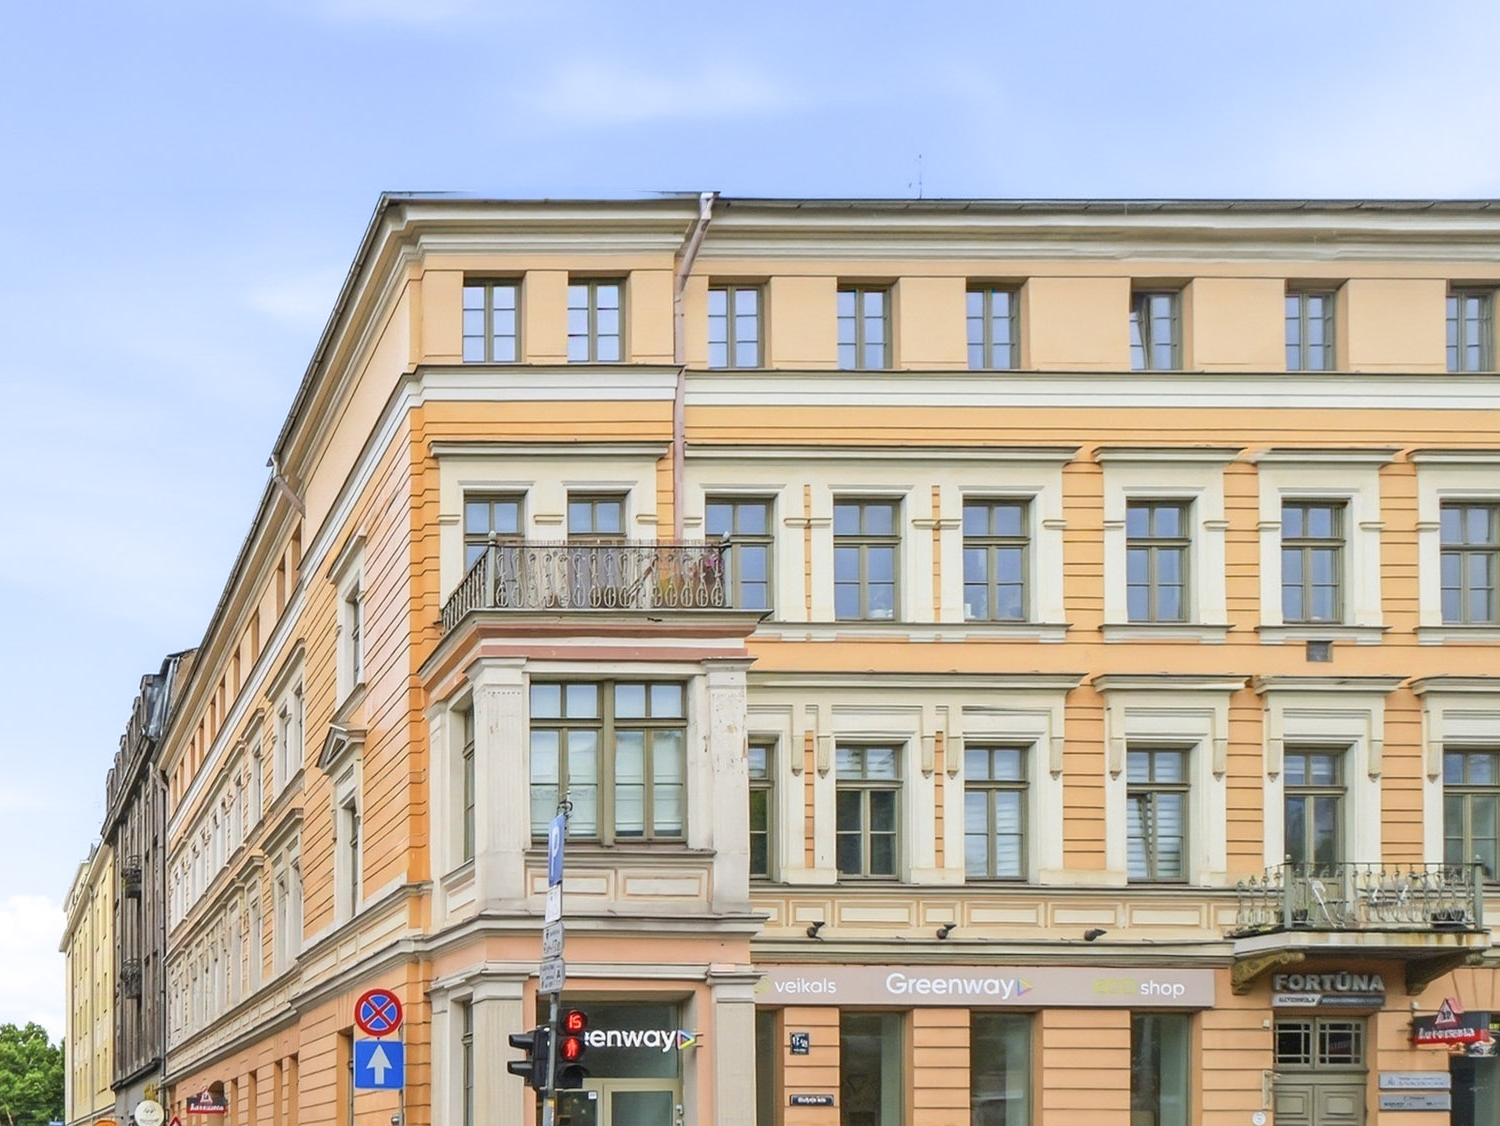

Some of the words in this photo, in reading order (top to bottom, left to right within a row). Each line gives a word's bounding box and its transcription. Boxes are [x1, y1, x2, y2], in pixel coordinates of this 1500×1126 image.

[774, 977, 837, 994] veikals
[886, 972, 1014, 1000] Greenway
[1140, 980, 1185, 999] shop
[1274, 971, 1385, 991] FORTŪNA
[569, 1014, 582, 1029] 15
